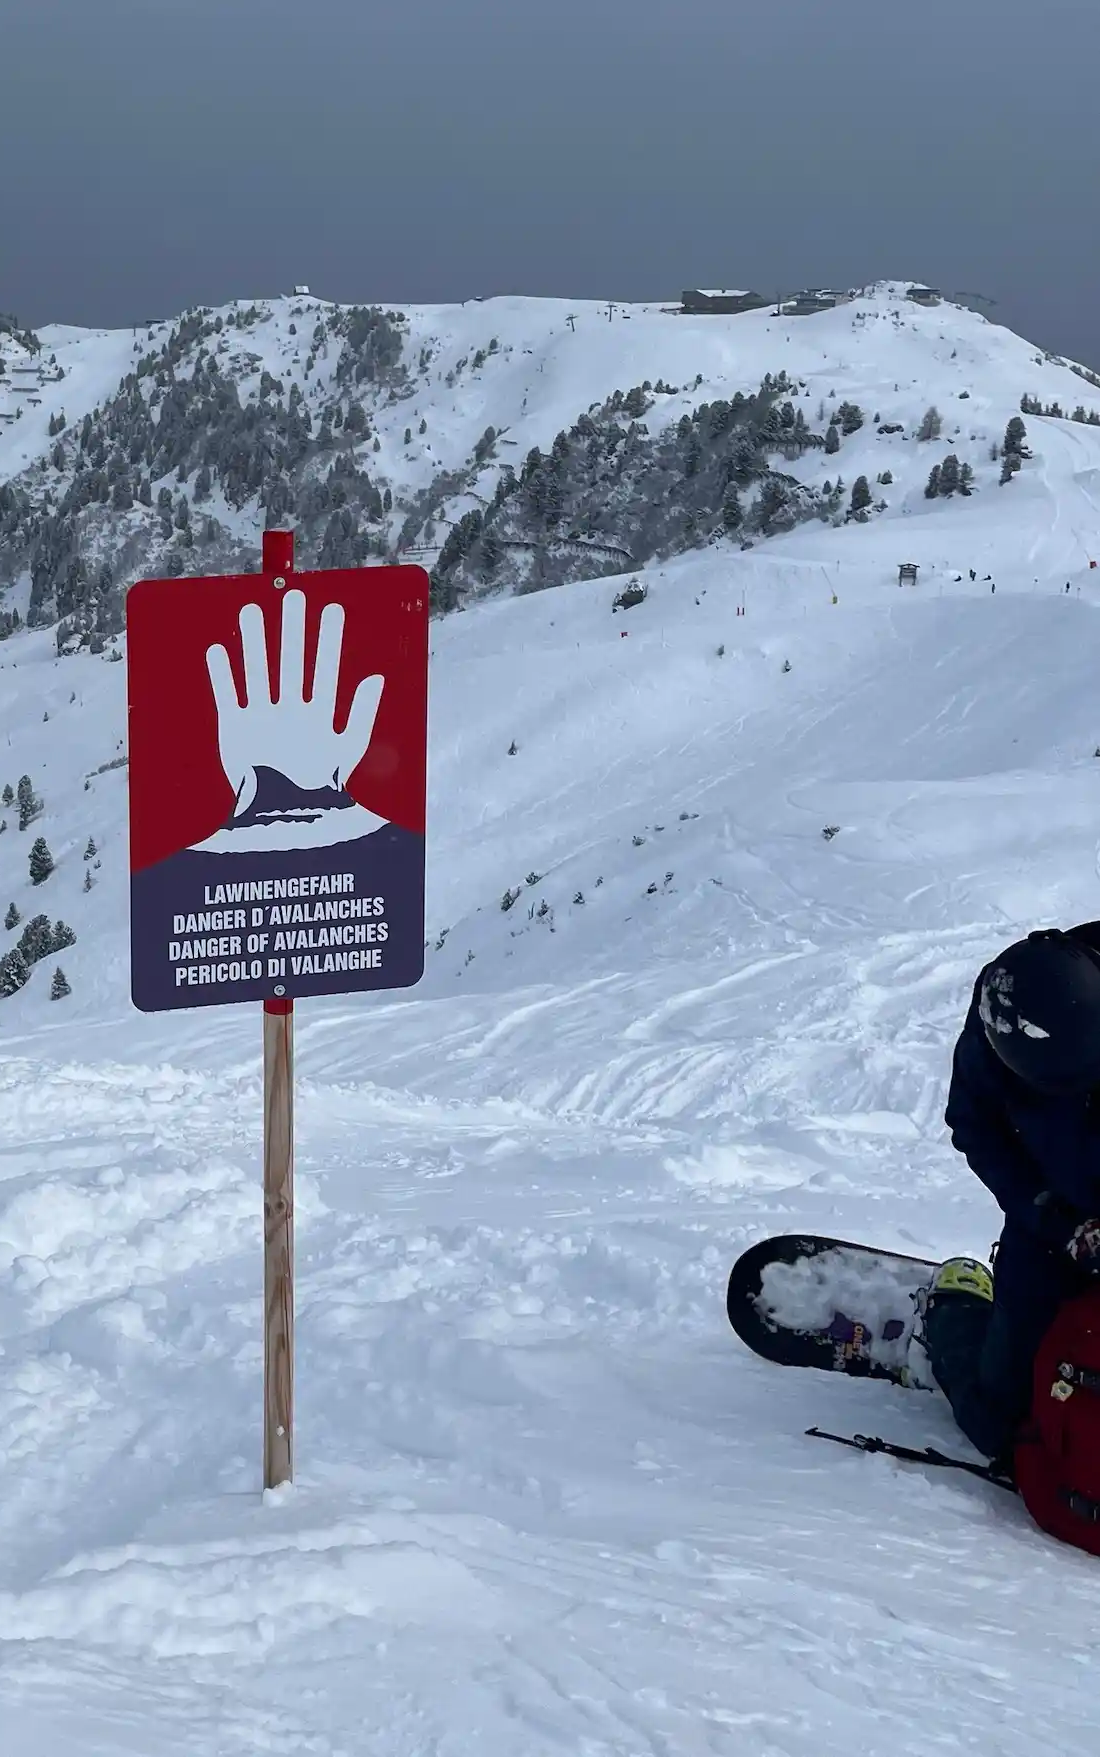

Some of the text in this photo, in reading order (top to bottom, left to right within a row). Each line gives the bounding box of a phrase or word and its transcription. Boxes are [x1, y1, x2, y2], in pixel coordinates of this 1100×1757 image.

[204, 873, 355, 905] LAWINENGEFAHR
[174, 910, 245, 934] DANGER
[169, 922, 389, 960] DANGER OF AVALANCHES
[176, 949, 381, 986] PERICOLO DI VALANGHE
